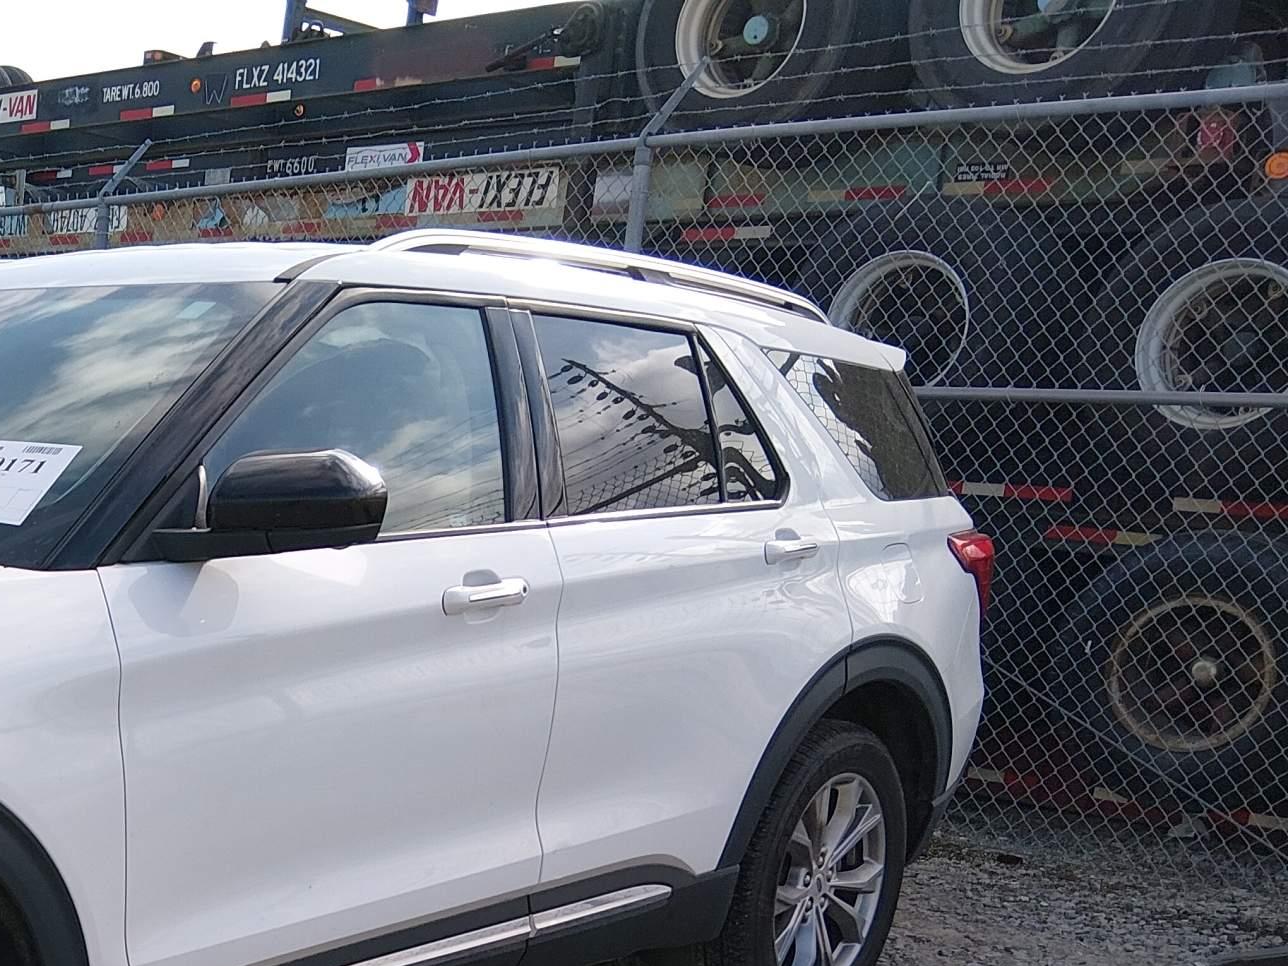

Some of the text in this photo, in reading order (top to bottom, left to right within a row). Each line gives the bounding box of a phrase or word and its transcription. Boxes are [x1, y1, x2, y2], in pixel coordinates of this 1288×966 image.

[235, 58, 320, 90] FLXZ 414321
[409, 170, 555, 213] FLEXI-VAN
